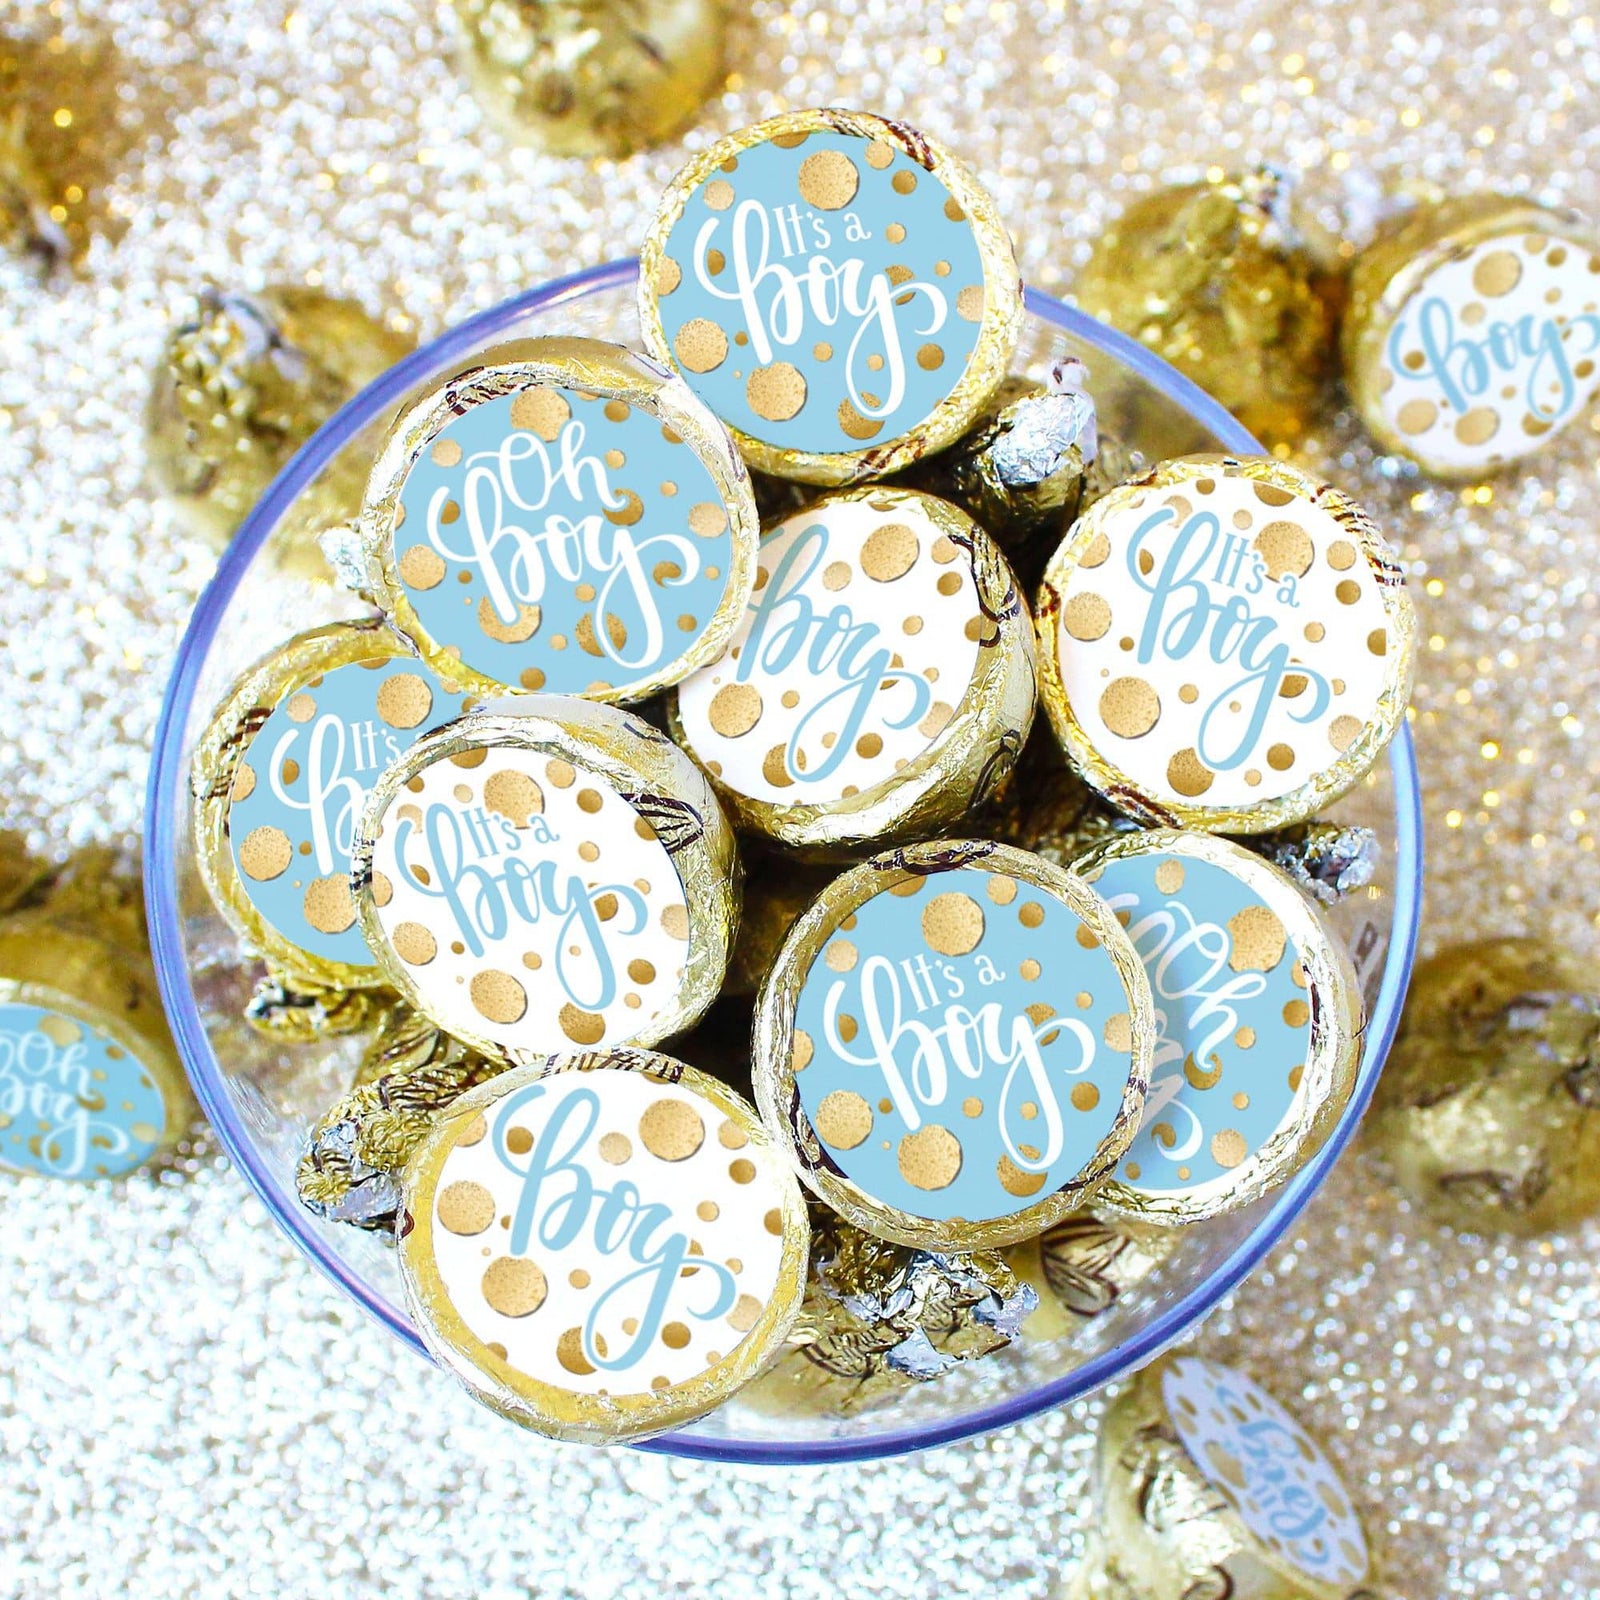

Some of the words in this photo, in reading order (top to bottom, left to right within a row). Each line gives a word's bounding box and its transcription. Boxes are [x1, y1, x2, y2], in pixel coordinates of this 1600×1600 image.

[773, 204, 831, 258] It's
[843, 211, 872, 241] a
[465, 421, 628, 511] Oh
[1211, 532, 1265, 594] It's
[1276, 575, 1300, 608] a
[463, 806, 519, 858] It's
[530, 813, 560, 851] a
[900, 953, 964, 1014] It's
[976, 957, 1006, 986] a
[1155, 901, 1267, 1068] Oh
